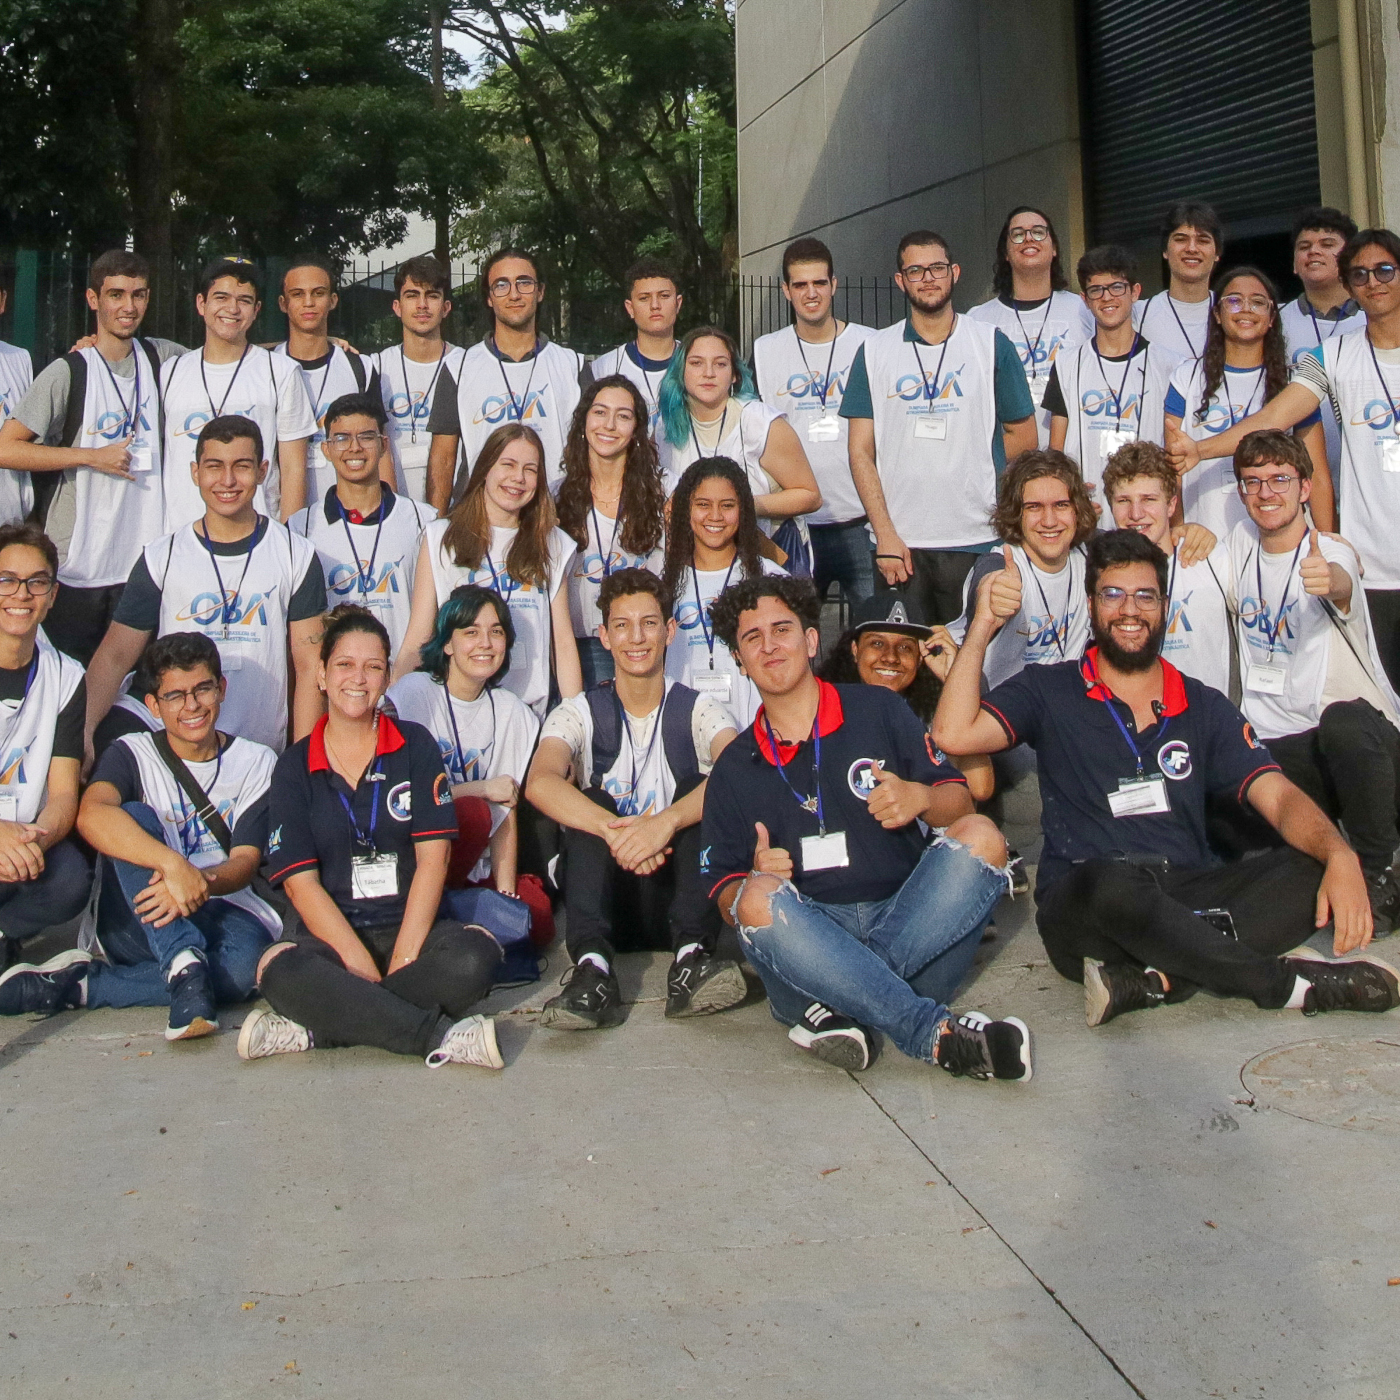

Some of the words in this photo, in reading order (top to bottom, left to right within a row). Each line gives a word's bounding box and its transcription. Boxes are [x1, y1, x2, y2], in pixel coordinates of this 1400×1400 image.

[787, 371, 846, 397] OBA
[895, 370, 963, 400] OBA
[389, 391, 430, 419] OB
[481, 392, 547, 425] OBA
[1081, 388, 1140, 419] OBA
[328, 562, 400, 595] OBA
[190, 591, 267, 626] OBA
[1240, 595, 1295, 639] OBA
